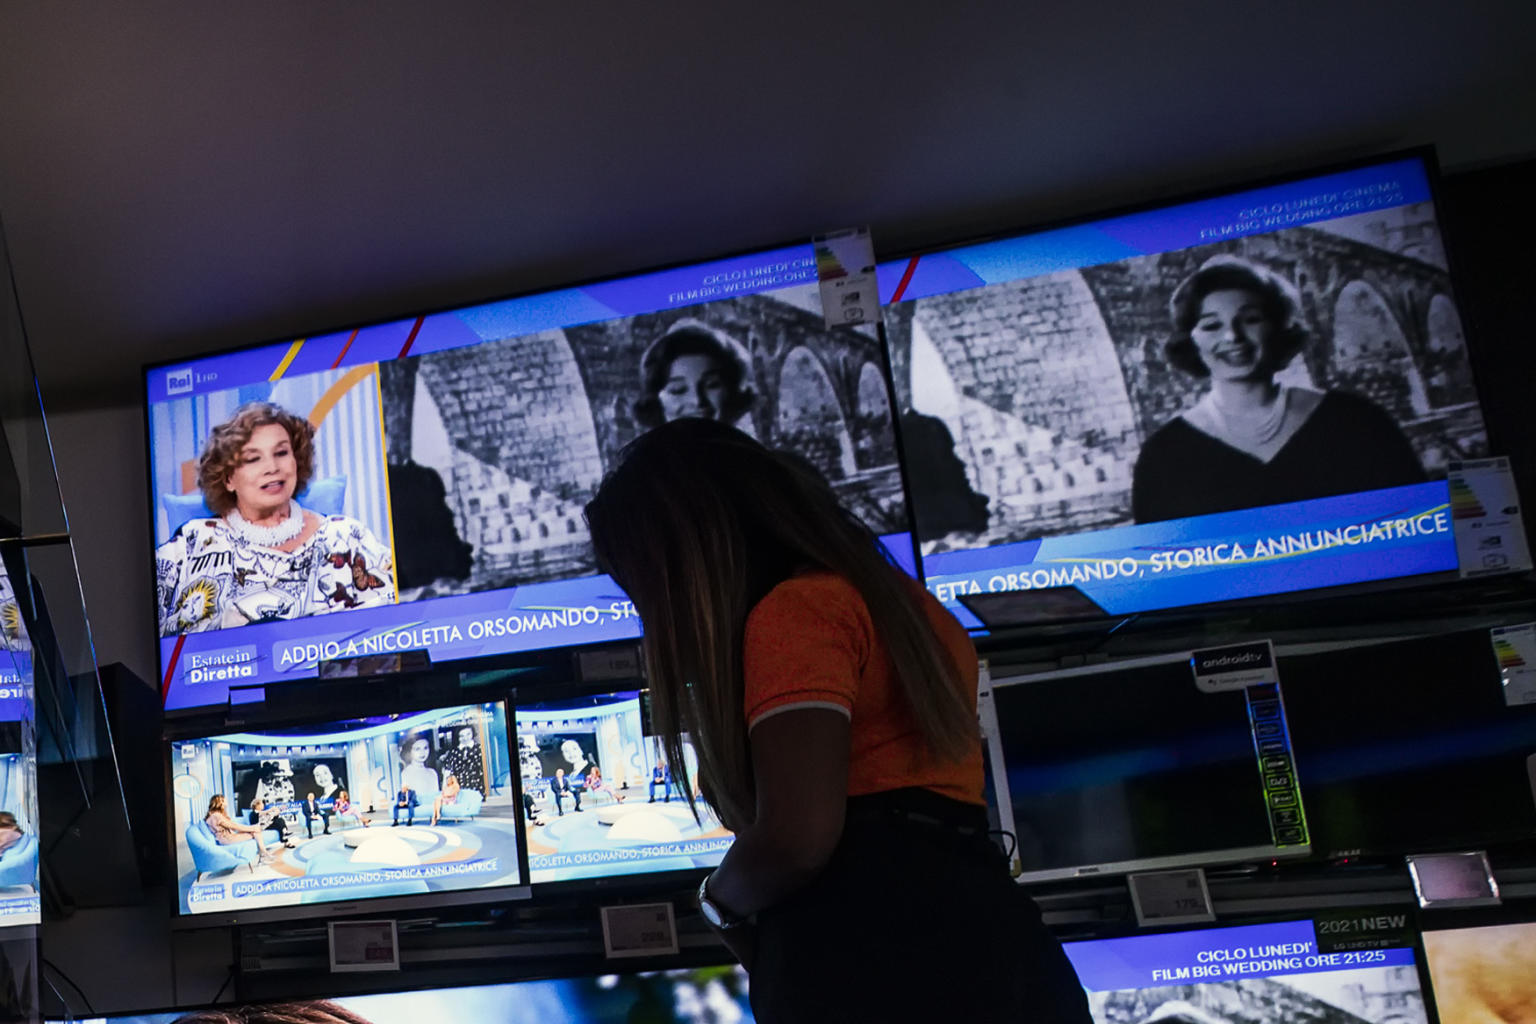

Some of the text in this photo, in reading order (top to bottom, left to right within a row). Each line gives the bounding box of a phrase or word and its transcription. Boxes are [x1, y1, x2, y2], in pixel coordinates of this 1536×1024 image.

[167, 373, 192, 390] Rai
[1152, 542, 1247, 573] STORICA
[1253, 513, 1449, 560] ANNUNCIATRICE
[280, 641, 341, 665] ADDIO
[346, 639, 358, 656] A
[362, 624, 463, 654] NICOLETTA
[468, 606, 605, 640] ORSOMANDO,
[191, 664, 252, 684] Diretta
[235, 883, 263, 895] ADDIO
[273, 878, 319, 891] NICOLETTA
[385, 868, 422, 881] STORICA
[1152, 949, 1386, 981] FILM BIG WEDDING ORE 21:25
[1197, 941, 1313, 964] CICLO LUNEDI'
